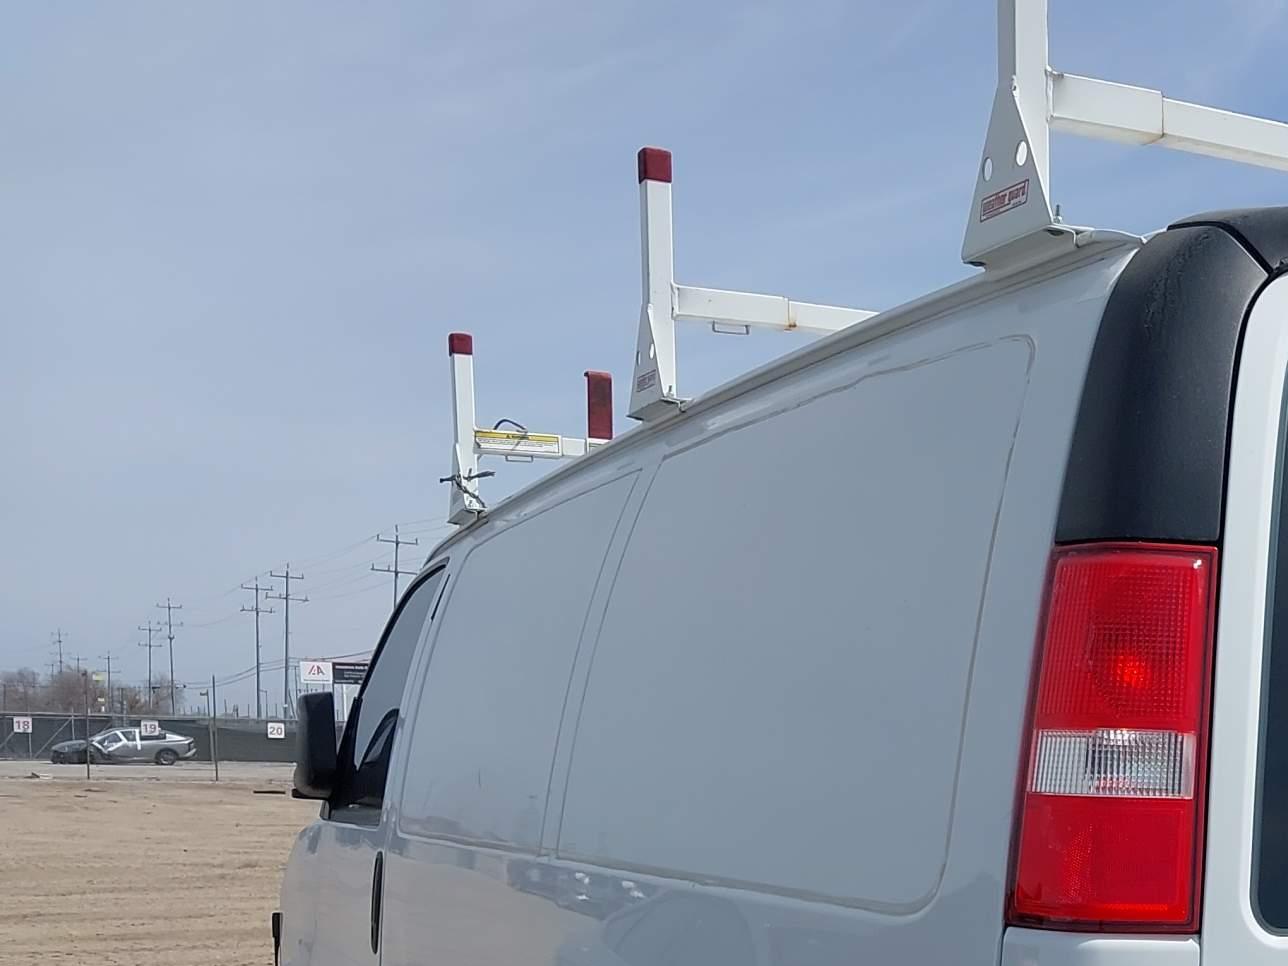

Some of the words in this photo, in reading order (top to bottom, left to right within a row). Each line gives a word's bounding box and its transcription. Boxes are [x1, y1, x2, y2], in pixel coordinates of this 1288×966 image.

[15, 720, 30, 730] 18
[143, 723, 157, 733] 19
[269, 726, 283, 736] 20
